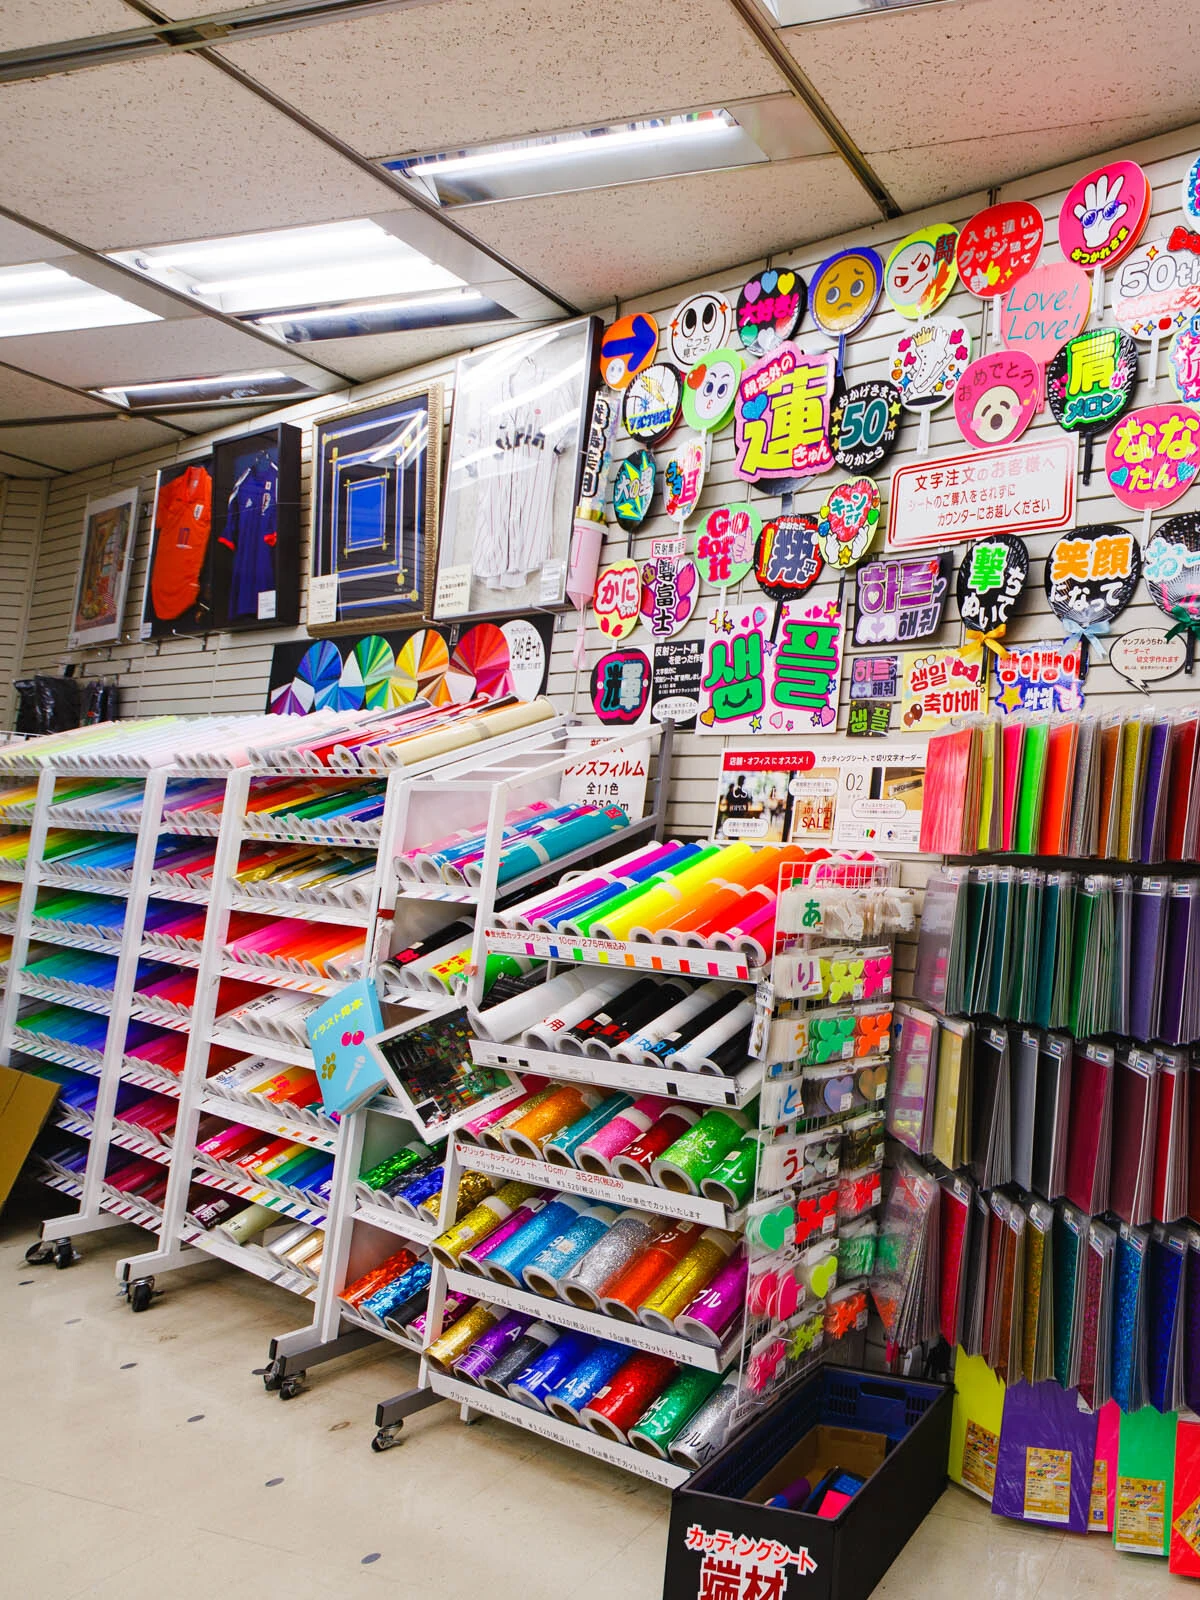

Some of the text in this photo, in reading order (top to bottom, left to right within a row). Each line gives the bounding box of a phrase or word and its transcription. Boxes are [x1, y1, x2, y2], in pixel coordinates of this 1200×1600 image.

[1010, 253, 1031, 267] して
[1006, 285, 1080, 312] Love!
[1007, 314, 1081, 340] Love!
[1070, 331, 1117, 397] 肩
[959, 362, 1036, 401] おめでとう
[627, 408, 674, 431] VICTORY
[741, 364, 829, 473] 蓮
[839, 400, 888, 447] 50
[1114, 416, 1199, 463] なな
[791, 439, 832, 469] きゅん
[835, 447, 885, 469] ありがとう
[914, 458, 1056, 494] 文字注文のお客様へ
[1129, 465, 1177, 491] たん
[831, 493, 867, 517] キュン
[908, 485, 1016, 512] シートのご購入をされずに
[845, 511, 861, 526] です
[937, 500, 1050, 527] カウンターにお越しください
[697, 532, 735, 559] for
[769, 529, 814, 584] 翔
[1053, 537, 1131, 581] 笑顔
[708, 557, 733, 582] it
[804, 560, 816, 578] 平
[602, 576, 636, 604] かに
[862, 563, 936, 613] 하트
[1052, 581, 1123, 610] になって
[899, 604, 938, 637] 해줘
[704, 624, 840, 720] 샘플
[911, 664, 947, 691] 생일
[924, 689, 979, 714] 축하해
[850, 706, 890, 733] 샘플
[586, 782, 619, 795] 全11色
[845, 773, 863, 791] 02
[802, 899, 822, 928] あ
[687, 1525, 816, 1573] カッティングシート
[702, 1556, 786, 1600] 端材
